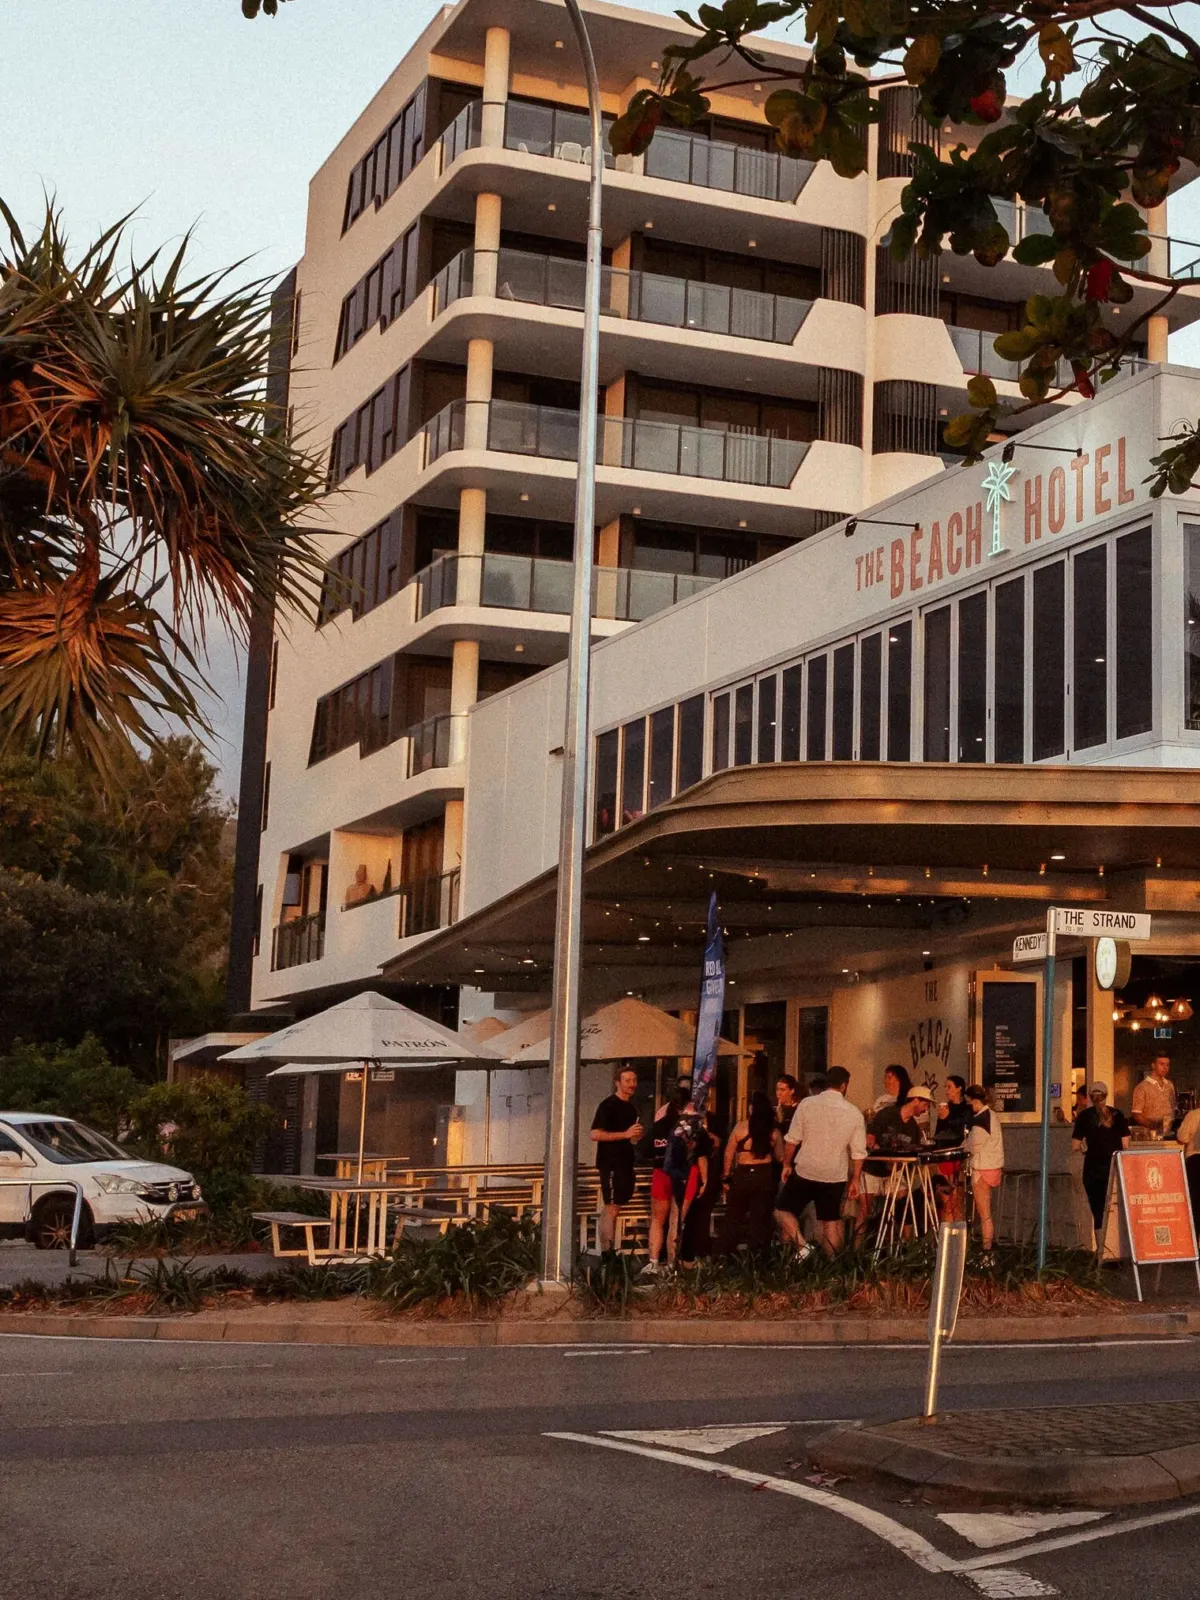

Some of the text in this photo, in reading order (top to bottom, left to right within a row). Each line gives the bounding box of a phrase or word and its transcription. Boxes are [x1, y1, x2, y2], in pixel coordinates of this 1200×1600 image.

[855, 436, 1134, 600] THE BEACH HOTEL
[1064, 911, 1136, 929] THE STRAND
[1015, 936, 1041, 951] KENNEDY
[925, 980, 938, 1002] THE
[381, 1039, 448, 1048] PATRÓN
[910, 1018, 952, 1069] BEACH
